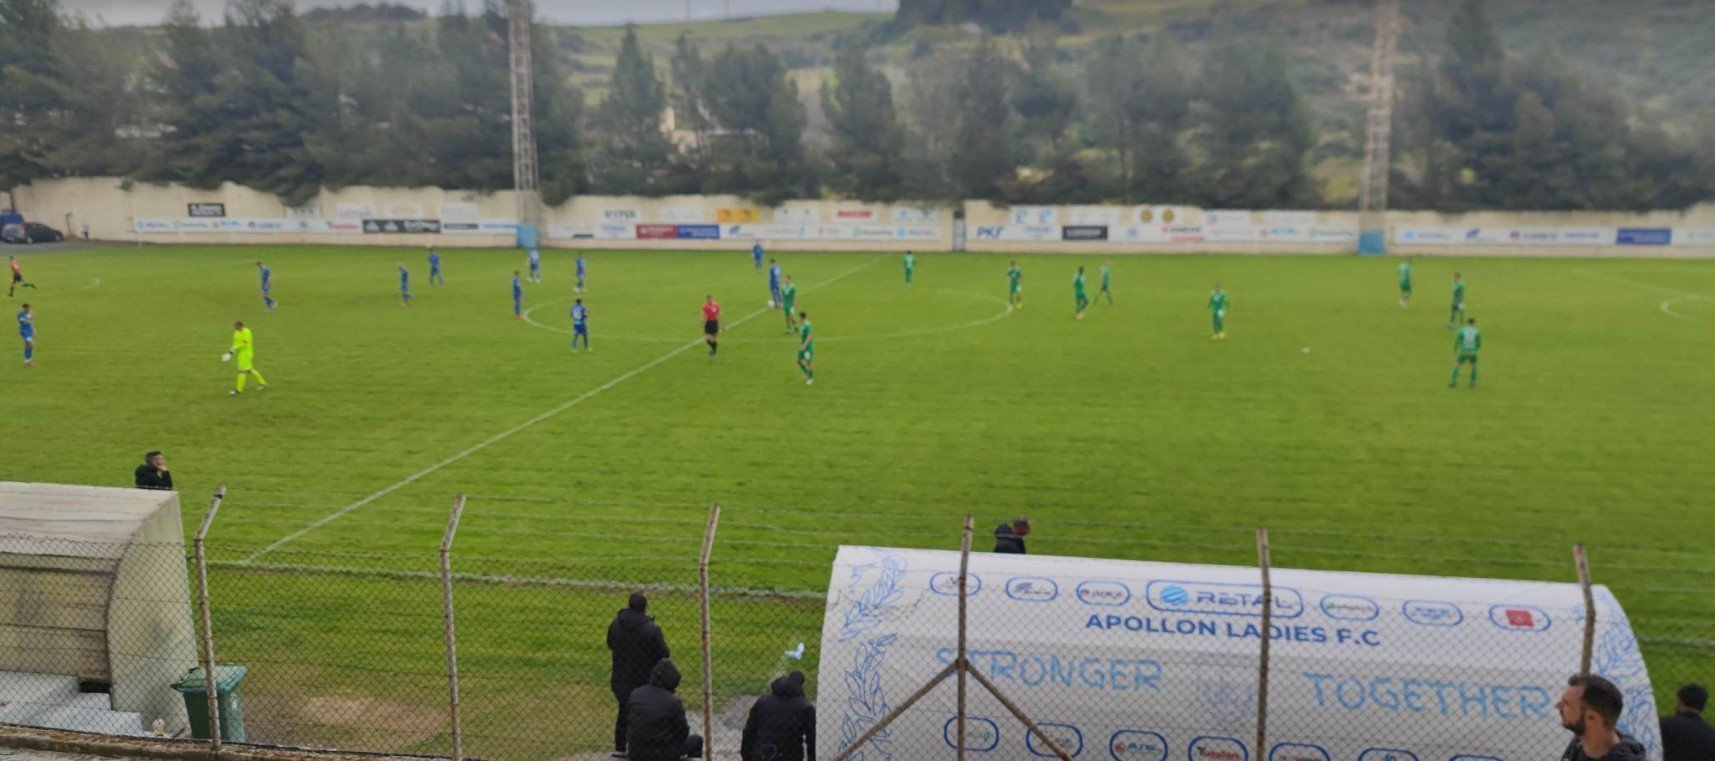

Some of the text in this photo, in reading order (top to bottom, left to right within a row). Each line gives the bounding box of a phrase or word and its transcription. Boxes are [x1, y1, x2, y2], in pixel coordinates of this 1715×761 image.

[1085, 614, 1381, 647] APOLLON LADIES F.C
[935, 646, 1550, 718] STRONGER TOGETHER
